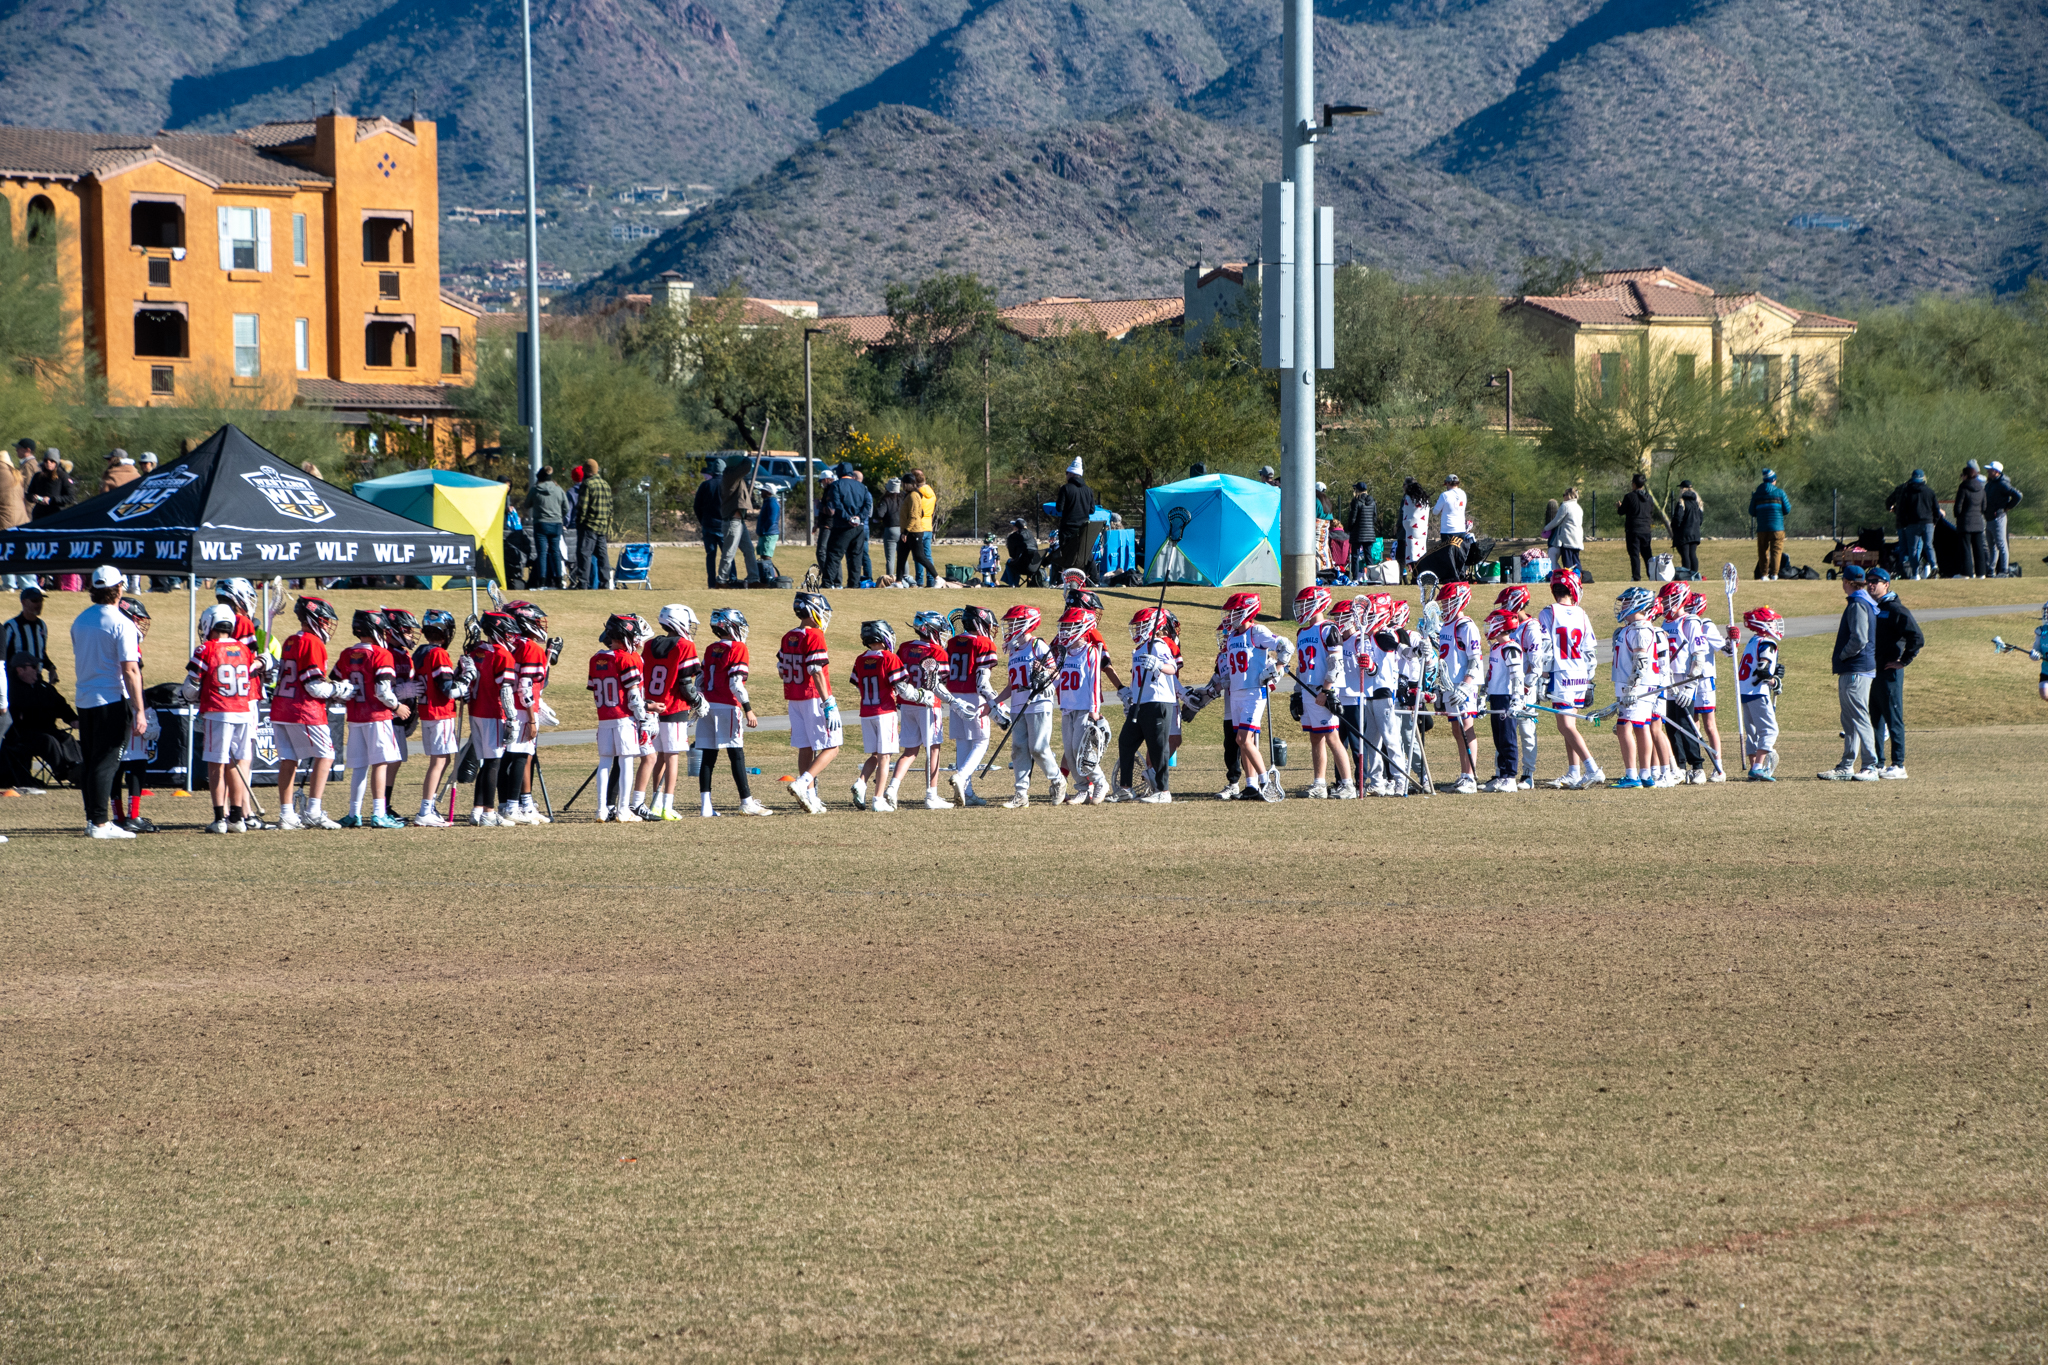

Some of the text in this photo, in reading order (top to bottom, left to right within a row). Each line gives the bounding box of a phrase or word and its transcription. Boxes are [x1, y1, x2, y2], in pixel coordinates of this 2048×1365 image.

[123, 488, 179, 504] WLF
[257, 487, 321, 505] WLF
[25, 542, 59, 560] WLF
[68, 541, 103, 559] WLF
[111, 541, 146, 559] WLF
[154, 541, 188, 560] WLF
[199, 541, 242, 561] WLF
[255, 543, 301, 561] WLF
[315, 542, 359, 561] WLF
[372, 544, 415, 563] WLF
[428, 545, 471, 564] WLF
[1556, 627, 1582, 659] 12
[783, 653, 804, 684] 55
[950, 652, 968, 682] 61
[1229, 650, 1249, 675] 99
[1738, 653, 1753, 681] 6
[217, 664, 251, 697] 92
[649, 665, 668, 696] 8
[707, 664, 716, 692] 1
[1008, 664, 1028, 690] 21
[1060, 670, 1080, 691] 20
[592, 676, 619, 708] 30
[862, 675, 881, 706] 11
